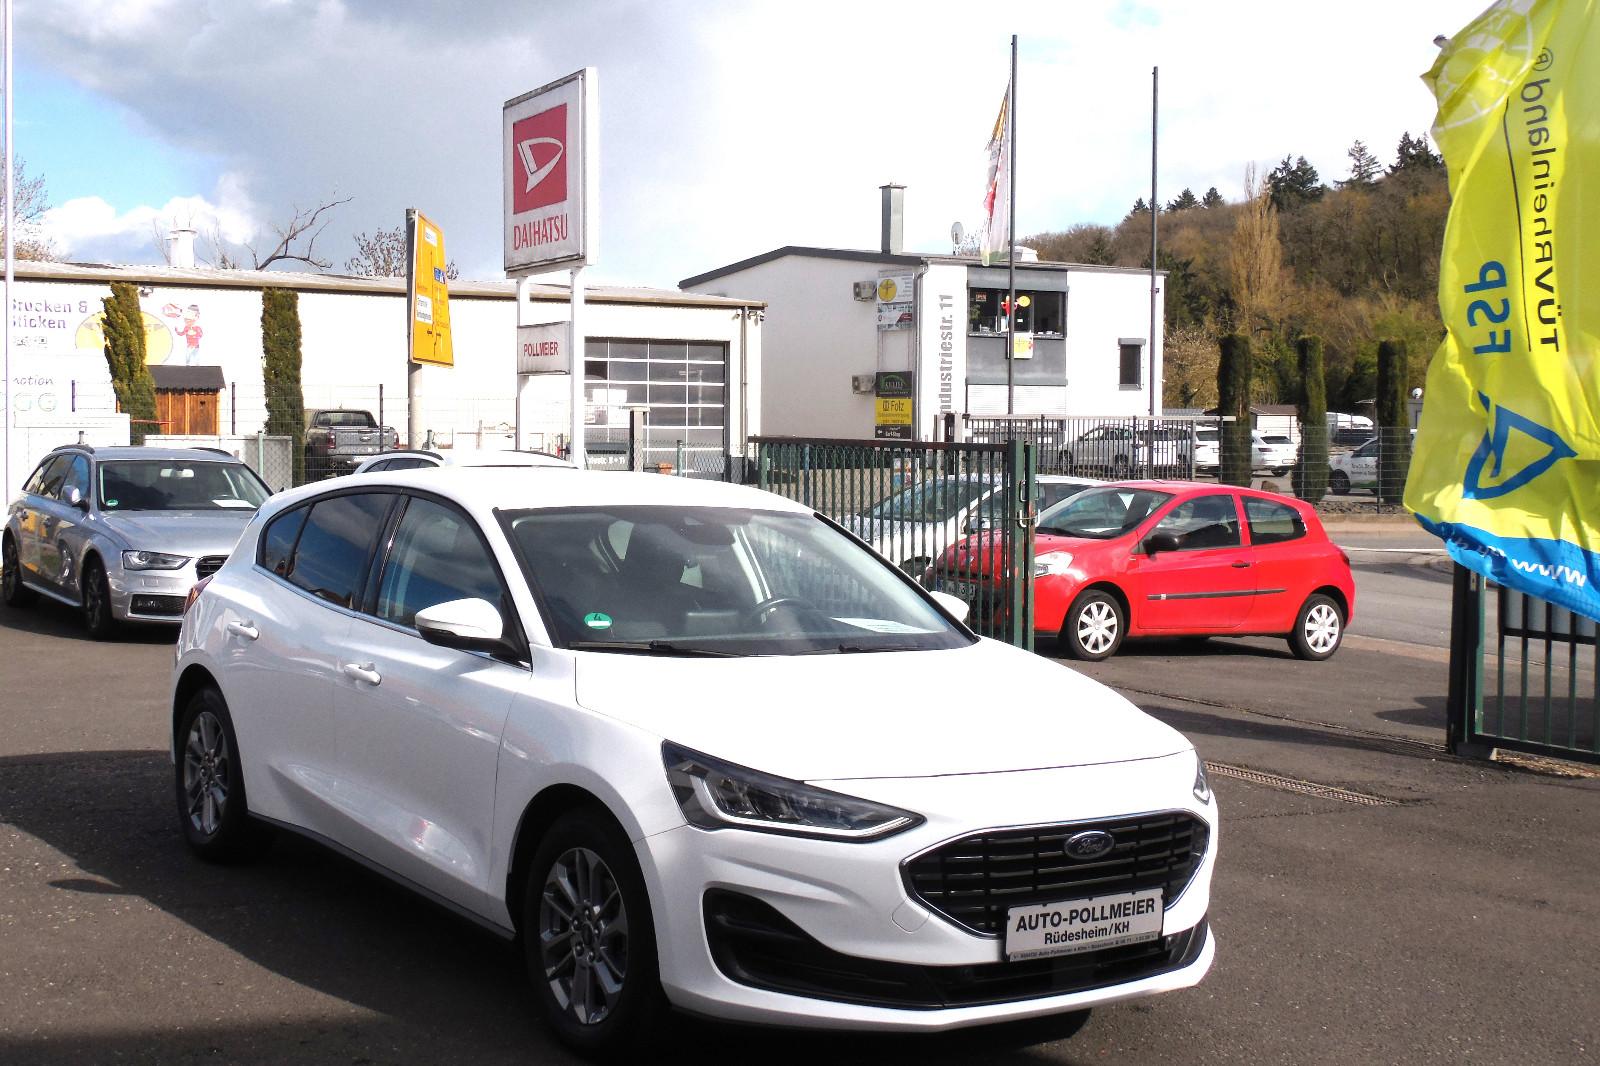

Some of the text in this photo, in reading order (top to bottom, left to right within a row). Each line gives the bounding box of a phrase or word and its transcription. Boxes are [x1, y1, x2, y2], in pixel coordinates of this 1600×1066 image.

[513, 213, 568, 251] DAIHATSU
[79, 301, 88, 313] &
[939, 294, 954, 310] 11
[523, 341, 559, 357] POLLMEIER
[890, 400, 905, 412] Folz
[1077, 836, 1105, 854] Ford
[1015, 897, 1155, 932] AUTO-POLLMEIER
[1044, 921, 1130, 945] Rüdesheim/KH
